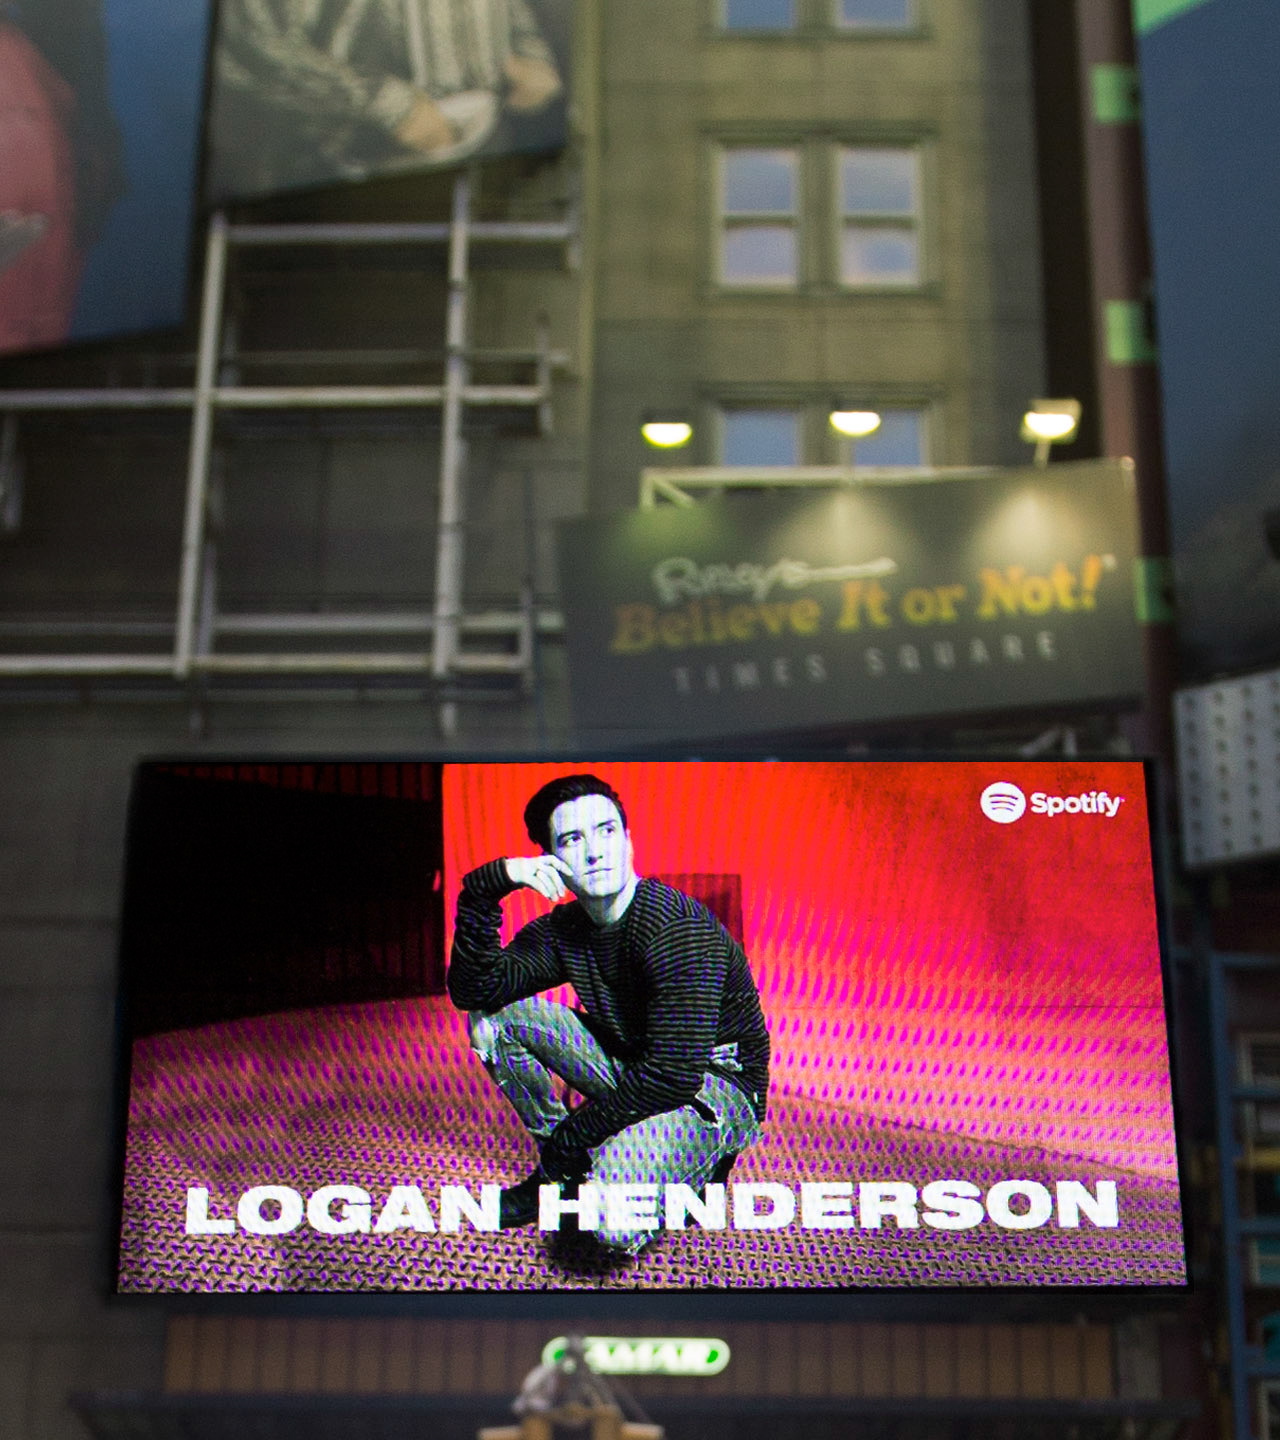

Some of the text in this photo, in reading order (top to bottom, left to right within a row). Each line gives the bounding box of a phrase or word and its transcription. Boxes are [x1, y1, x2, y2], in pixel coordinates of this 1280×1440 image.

[611, 596, 822, 654] Believe
[836, 580, 891, 631] It
[902, 584, 967, 626] or
[865, 630, 1055, 675] SQUARE
[1030, 790, 1121, 817] Spotify
[183, 1178, 1120, 1236] LOGAN HENDERSON
